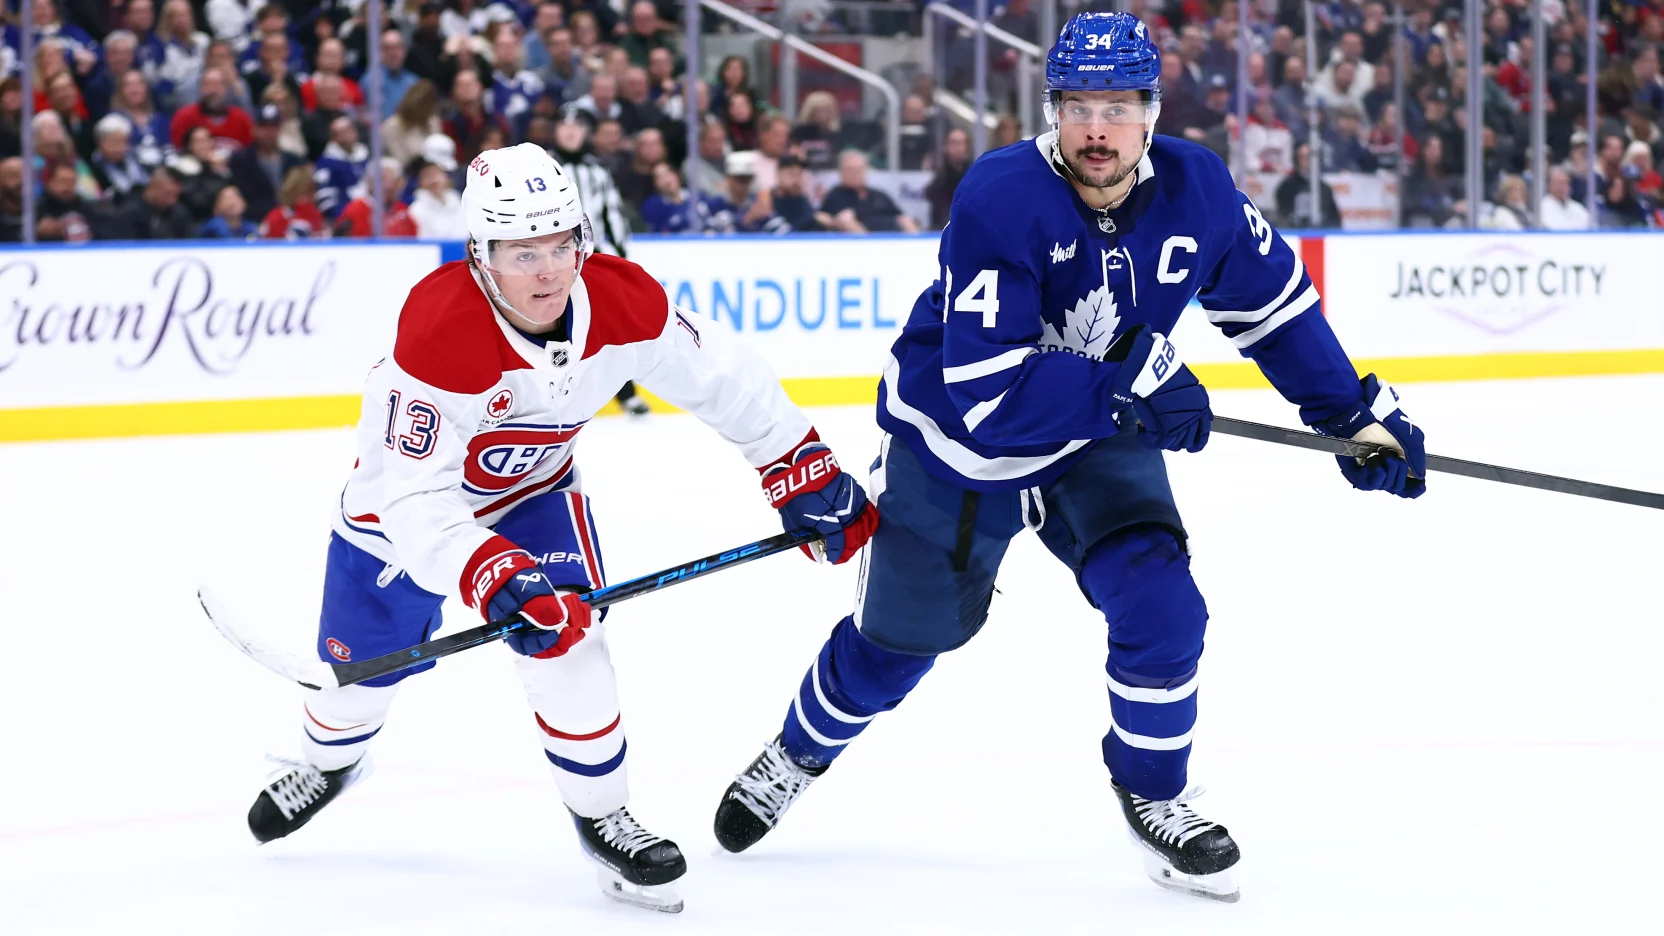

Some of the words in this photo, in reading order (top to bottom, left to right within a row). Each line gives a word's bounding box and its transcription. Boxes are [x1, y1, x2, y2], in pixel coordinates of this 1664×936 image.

[1084, 33, 1112, 50] 34
[525, 177, 547, 193] 13
[525, 207, 561, 219] BAUER
[1243, 200, 1273, 256] 3
[1156, 235, 1199, 284] C
[1390, 262, 1528, 299] JACKPOT
[1537, 260, 1607, 297] CITY
[114, 255, 337, 377] Royal
[660, 278, 897, 333] ANDUEL
[383, 389, 441, 460] 13
[763, 453, 840, 504] BAUER
[655, 542, 761, 589] PULSE
